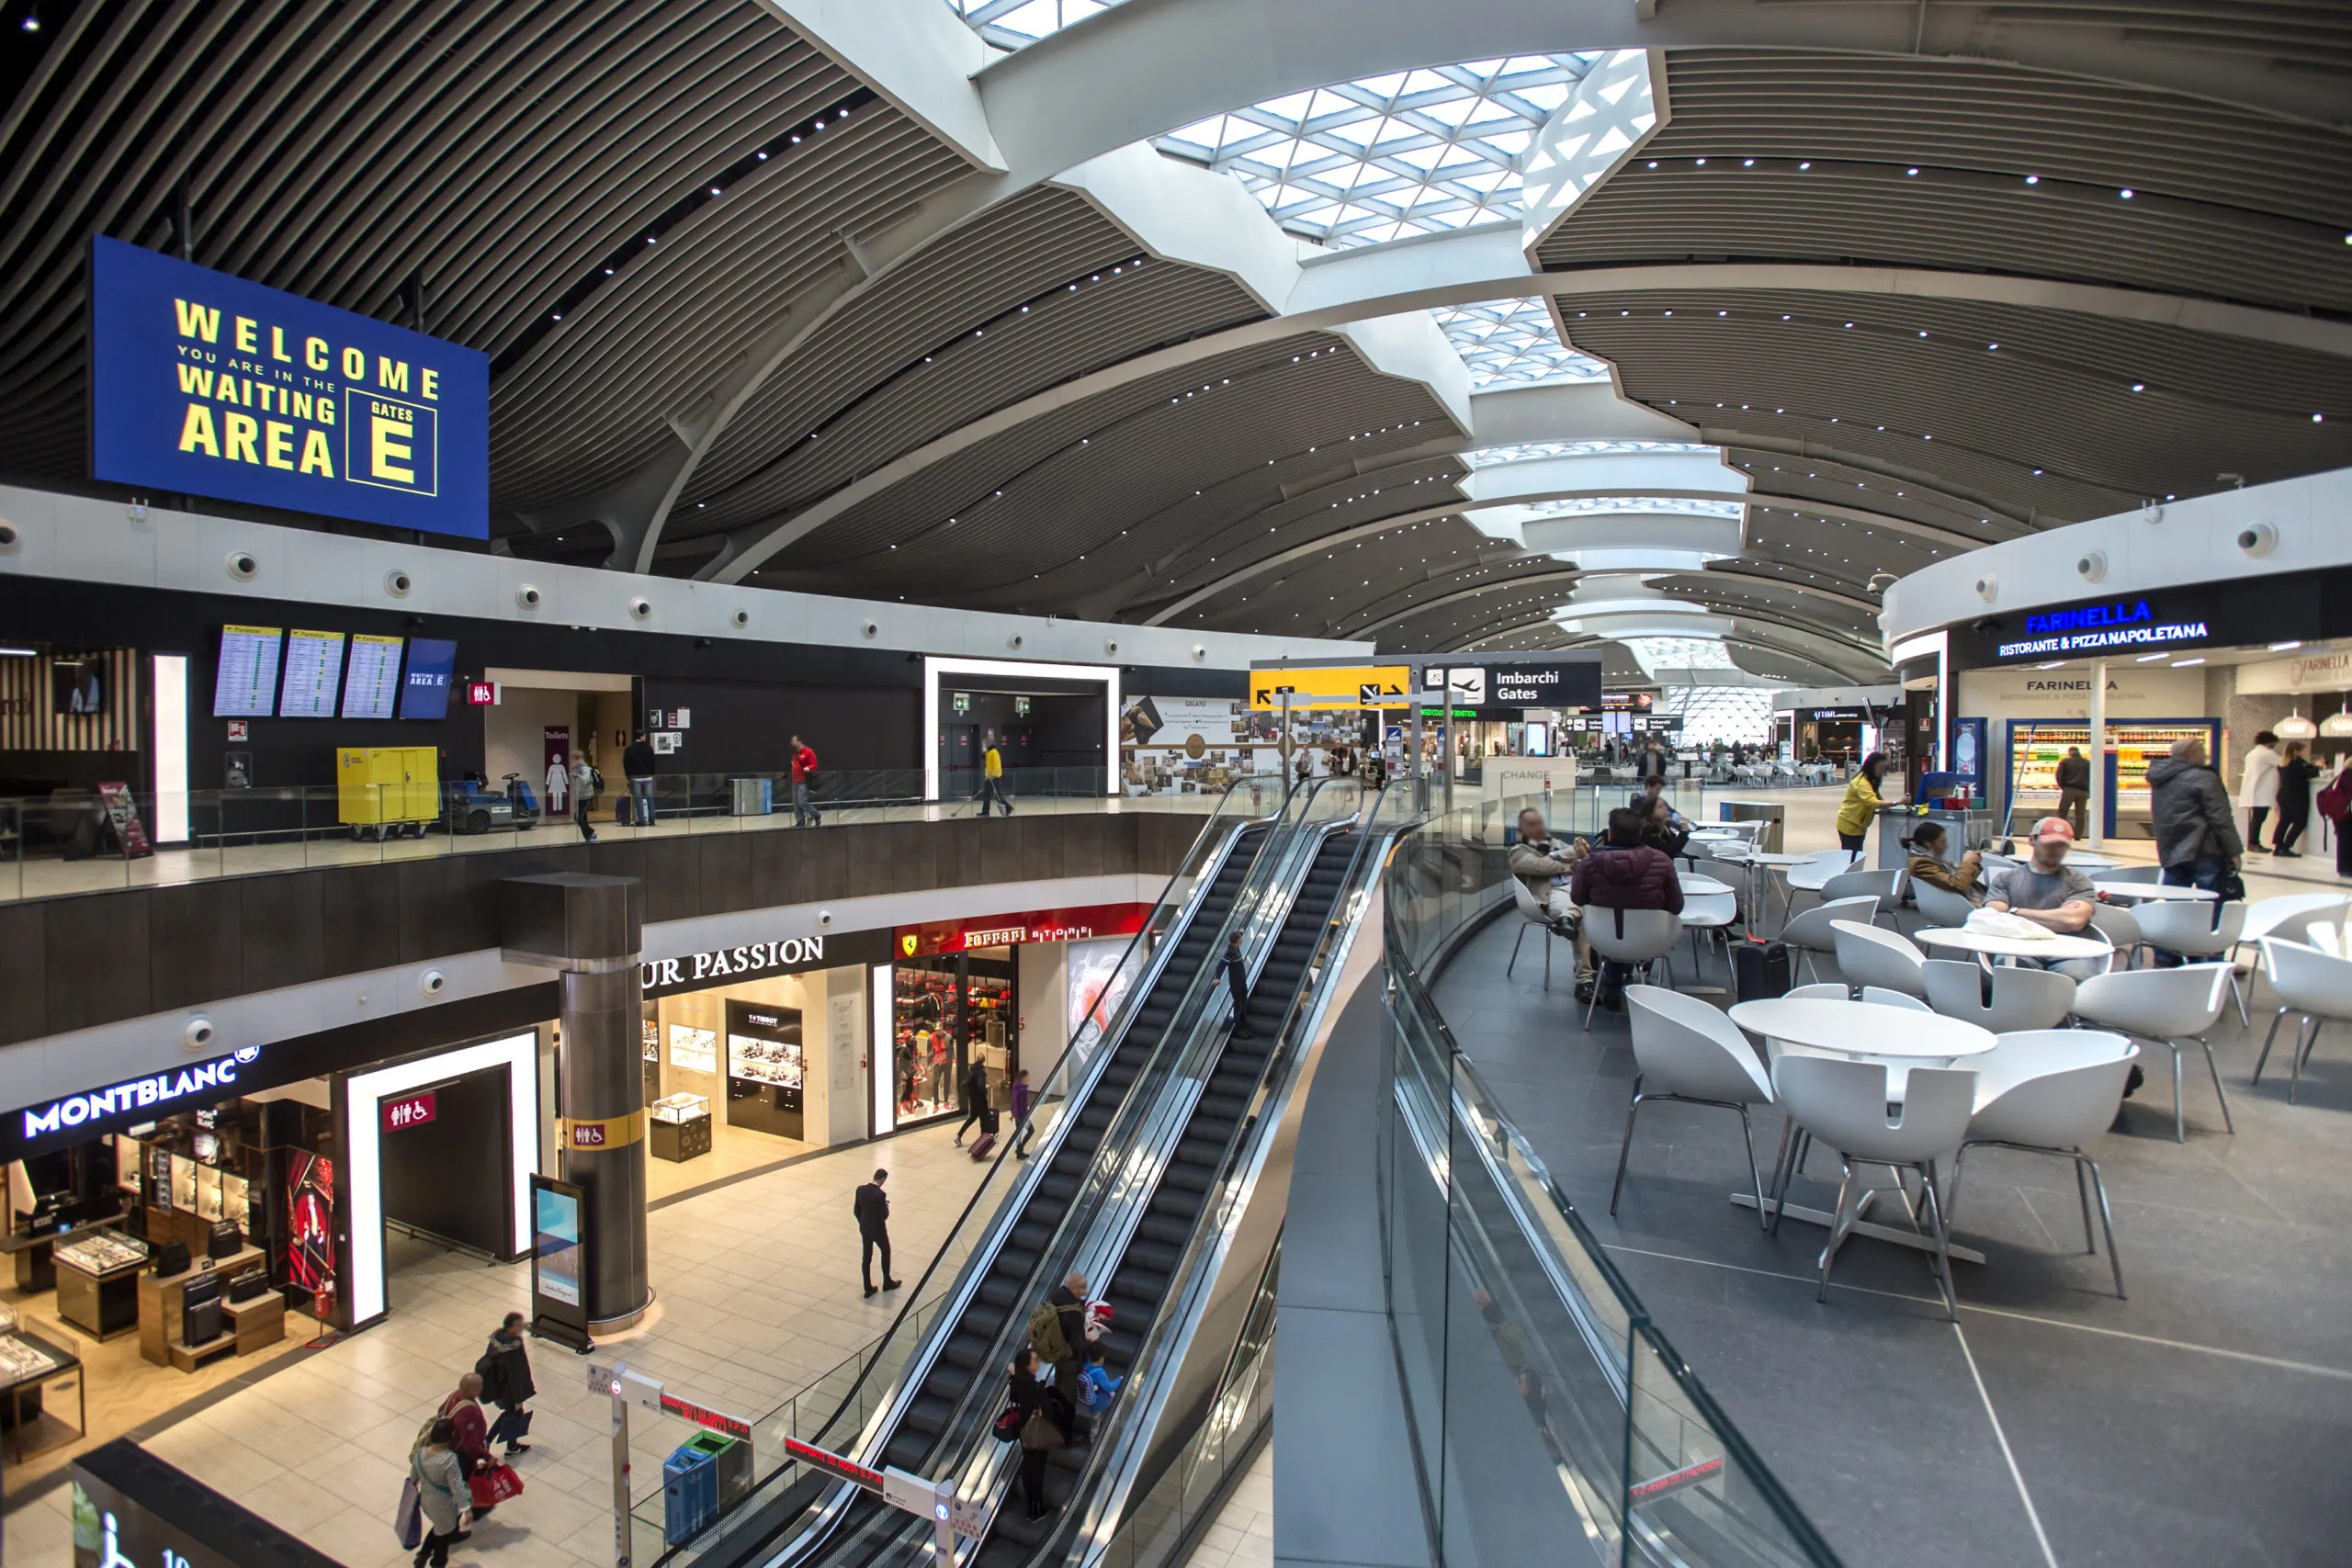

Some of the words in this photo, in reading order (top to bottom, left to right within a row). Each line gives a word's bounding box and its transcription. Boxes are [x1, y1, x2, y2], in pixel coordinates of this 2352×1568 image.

[175, 298, 439, 400] WELCOME
[177, 345, 216, 364] YOU
[229, 357, 264, 376] ARE
[275, 368, 293, 383] IN
[303, 376, 335, 393] THE
[177, 363, 335, 425] WAITING
[371, 400, 413, 423] GATES
[178, 402, 334, 479] AREA
[371, 416, 414, 484] E
[2026, 600, 2153, 635] FARINELLA
[1998, 638, 2059, 657] RISTORANTE
[2061, 636, 2070, 650] &
[2071, 633, 2108, 649] PIZZA
[2108, 622, 2209, 646] NAPOLETANA
[410, 677, 433, 685] AREA
[1497, 671, 1559, 684] Imbarchi
[1498, 689, 1538, 700] Gates
[2027, 681, 2118, 691] FARINELA
[545, 731, 569, 739] Toilets
[1502, 771, 1550, 780] CHANGE
[965, 927, 1026, 948] Ferrari
[641, 958, 684, 989] UR
[693, 936, 823, 980] PASSION
[24, 1057, 237, 1139] MONTBLANC
